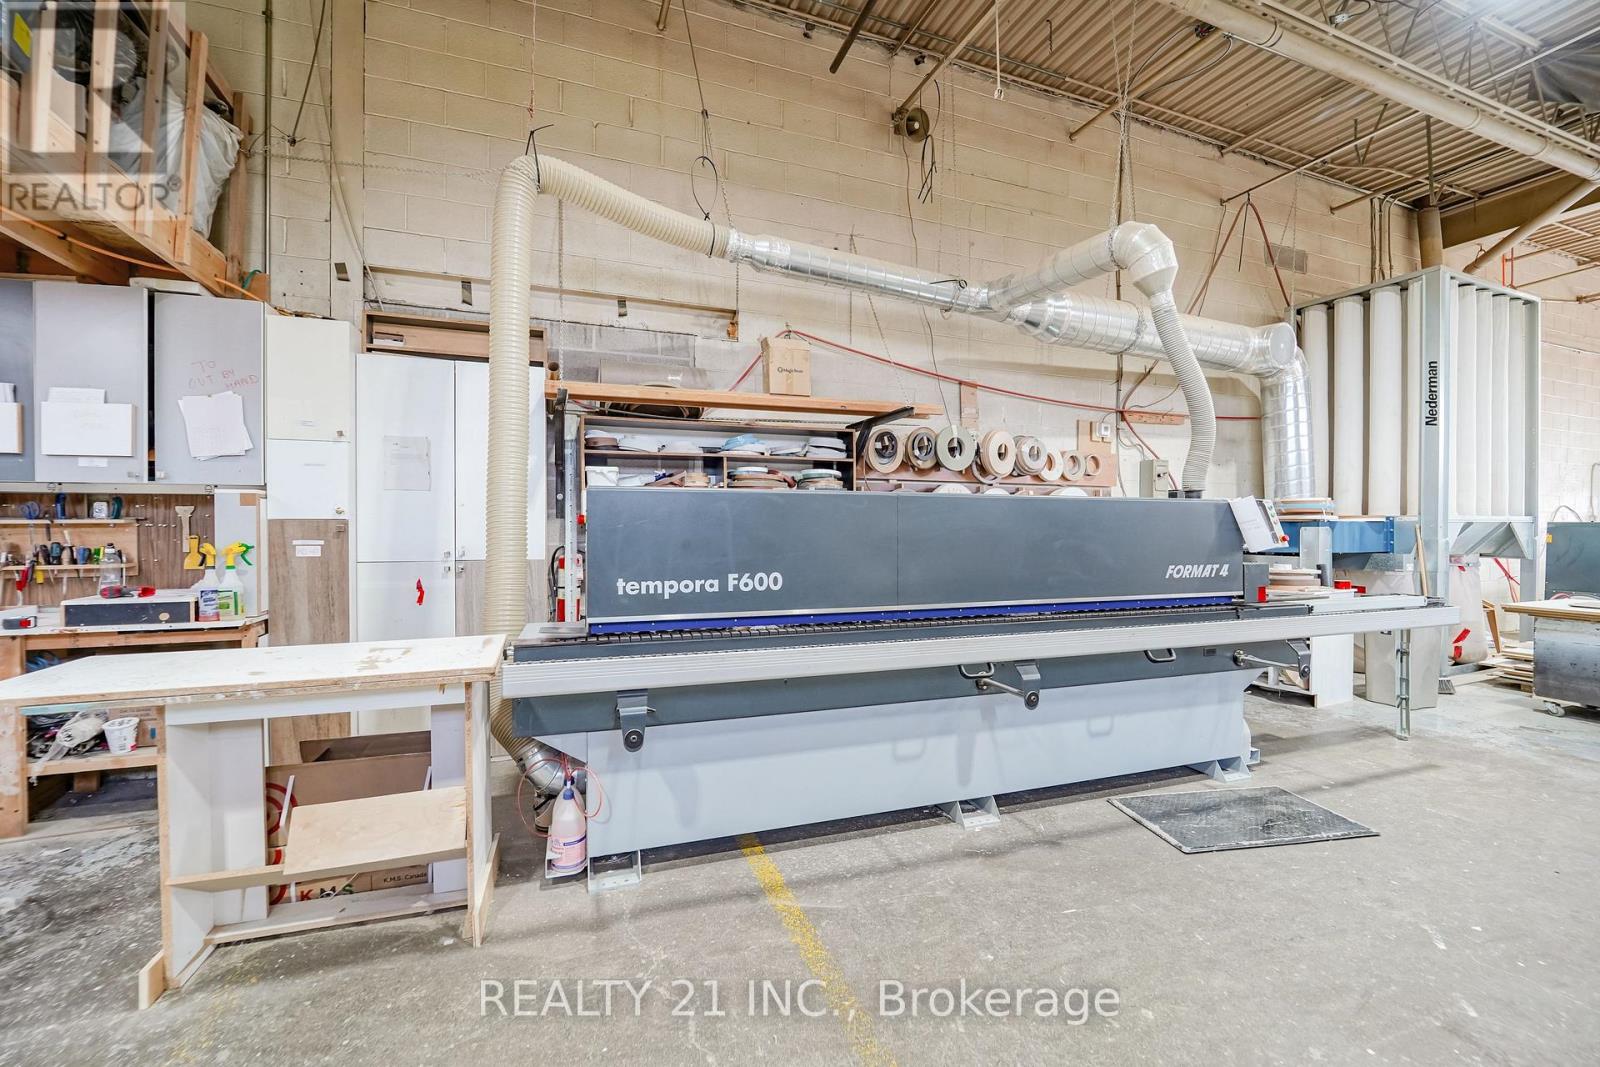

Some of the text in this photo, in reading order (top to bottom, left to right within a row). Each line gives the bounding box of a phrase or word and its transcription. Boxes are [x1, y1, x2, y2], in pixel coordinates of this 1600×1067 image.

[225, 374, 259, 390] HAND
[1425, 360, 1438, 426] Nederman
[1165, 564, 1230, 579] FORMAT 4
[616, 572, 783, 600] tempora F600
[404, 872, 427, 880] Canada
